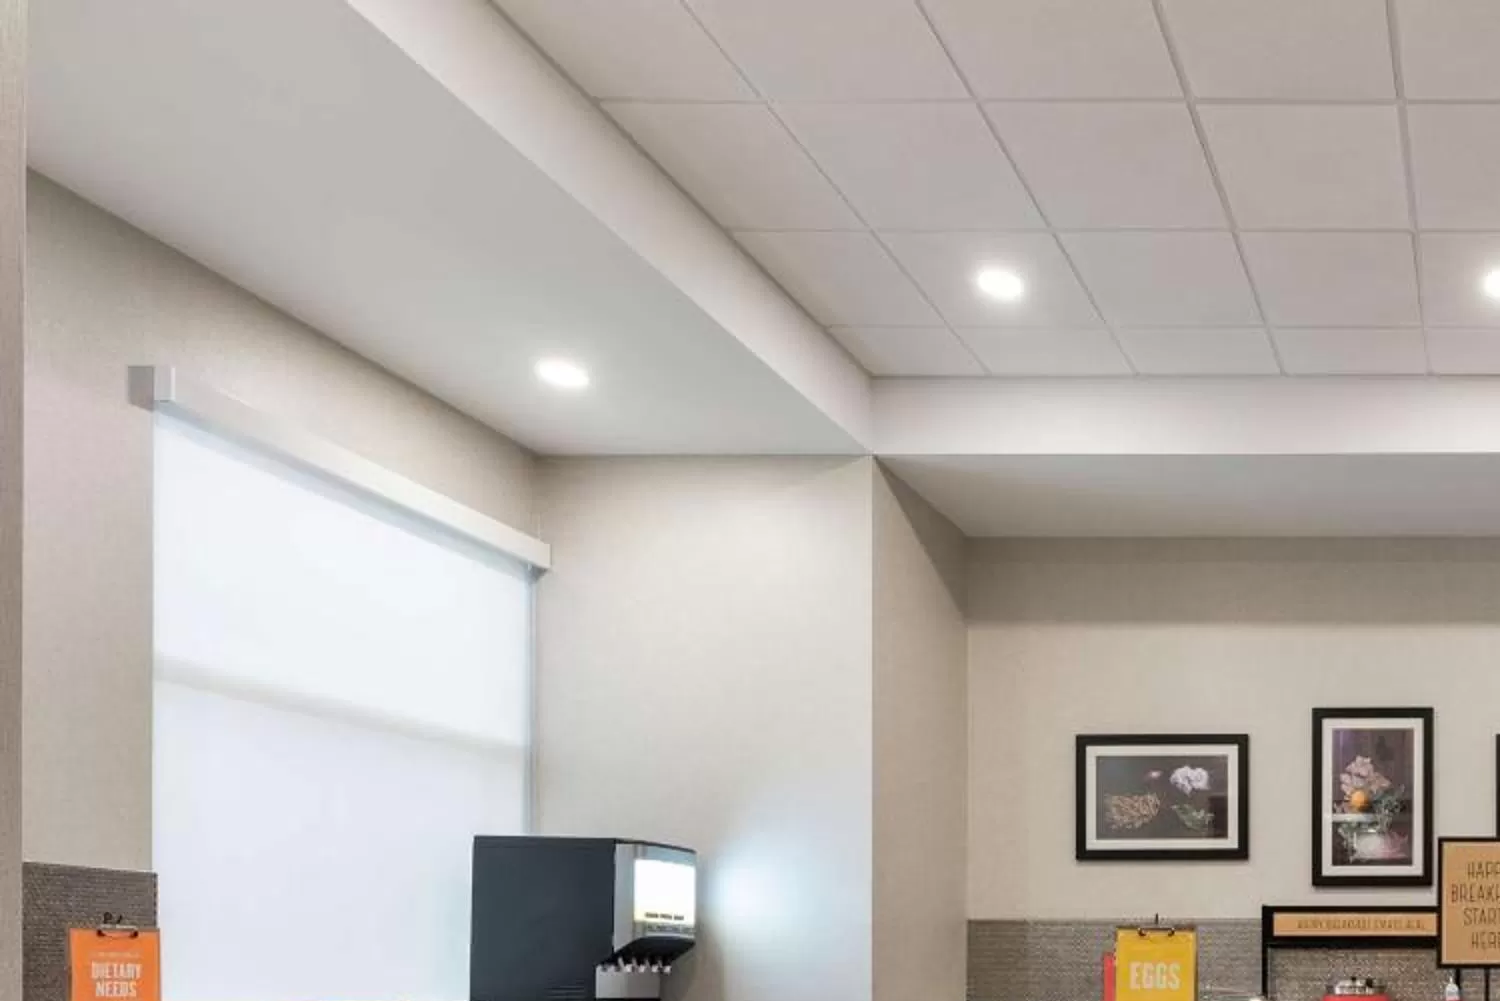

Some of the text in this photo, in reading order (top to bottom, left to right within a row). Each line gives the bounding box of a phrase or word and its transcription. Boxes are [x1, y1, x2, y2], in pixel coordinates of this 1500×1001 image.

[91, 961, 142, 979] DIETARY
[1129, 962, 1181, 990] EGGS
[95, 981, 137, 997] NEEDS
